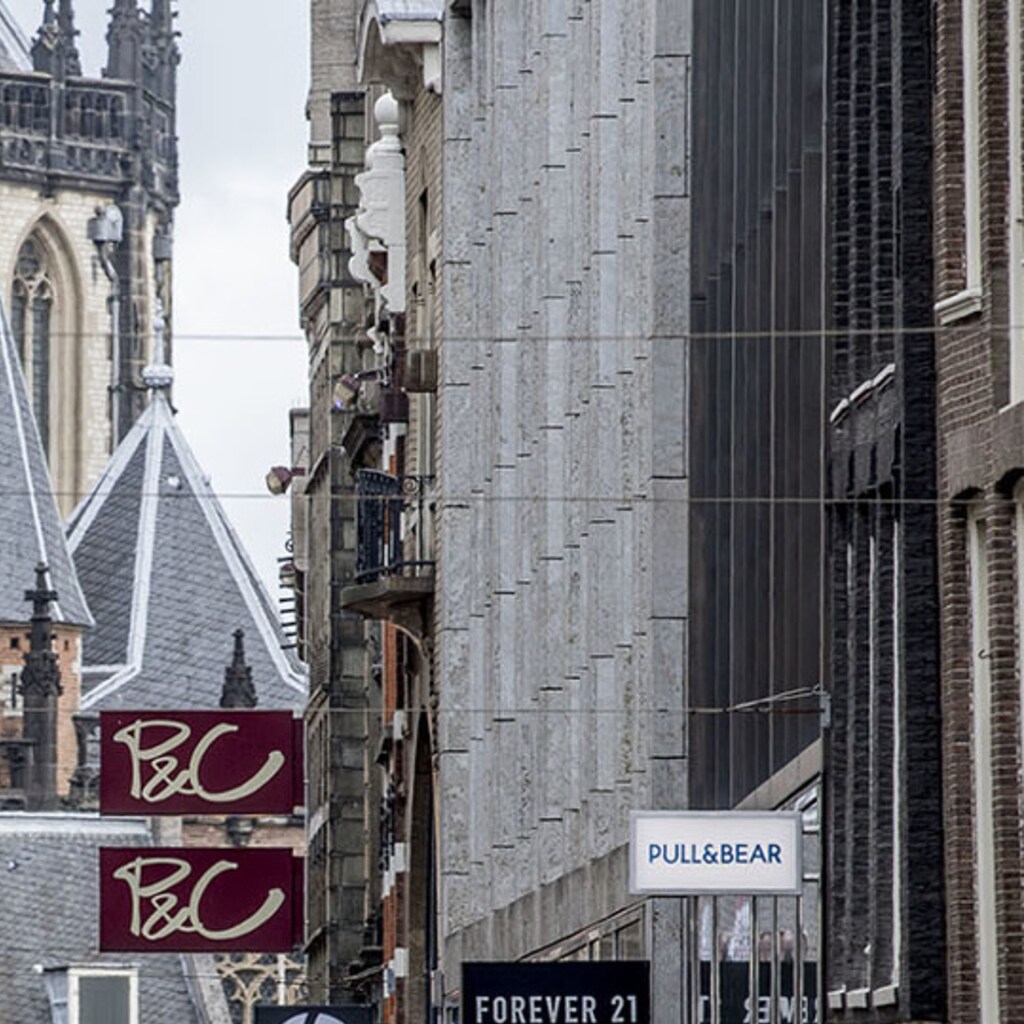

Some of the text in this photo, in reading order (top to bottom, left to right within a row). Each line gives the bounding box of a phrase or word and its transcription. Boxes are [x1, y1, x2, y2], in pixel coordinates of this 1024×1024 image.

[114, 719, 285, 802] P&C
[648, 843, 782, 864] PULL&BEAR
[114, 856, 285, 940] P&C
[476, 995, 638, 1024] FOREVER 21
